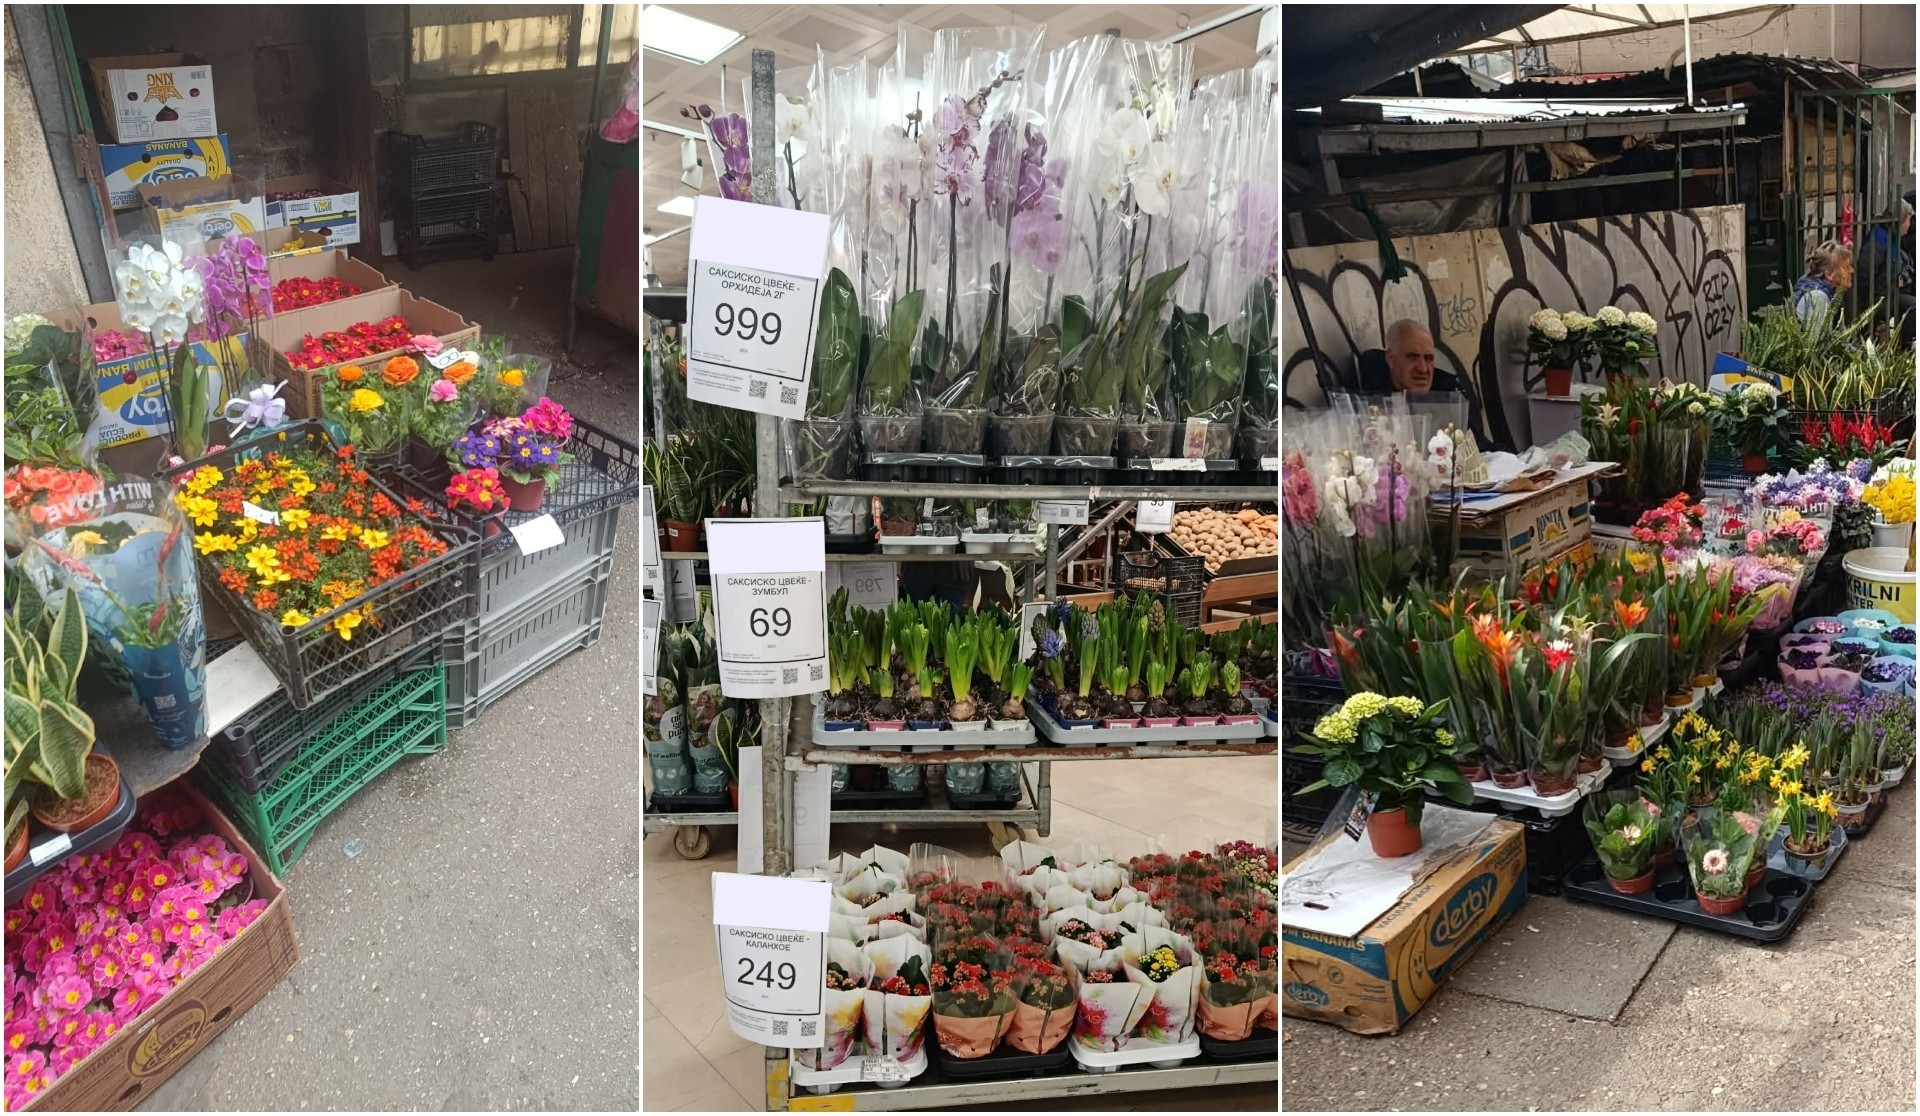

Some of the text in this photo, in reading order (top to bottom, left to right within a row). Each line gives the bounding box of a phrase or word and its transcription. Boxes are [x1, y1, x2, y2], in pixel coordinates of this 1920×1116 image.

[147, 72, 174, 86] KING
[145, 139, 188, 152] BANANAS
[156, 158, 182, 166] QUALITY
[708, 266, 761, 284] САКСИСКО
[763, 276, 795, 292] ЦВЕЌЕ
[1702, 270, 1729, 303] RIP
[721, 279, 785, 300] ОРХИДЕЈА 2Г
[714, 302, 782, 346] 999
[100, 427, 125, 439] ECUA
[100, 430, 141, 446] PRODUC
[1536, 506, 1567, 544] BONITA
[727, 577, 776, 586] САКСИСКО
[778, 575, 807, 587] ЦВЕЌЕ
[752, 587, 789, 596] ЗУМБУЛ
[749, 607, 792, 638] 69
[670, 711, 683, 724] air
[672, 722, 682, 730] so
[1411, 884, 1434, 907] PACK
[1436, 879, 1493, 942] derby
[729, 928, 775, 941] САКСИСКО
[776, 934, 805, 943] ЦВЕЌЕ
[1302, 930, 1366, 952] BANANAS
[745, 940, 791, 952] КАЛАНХОЕ
[737, 957, 797, 990] 249
[1286, 983, 1326, 1006] derby
